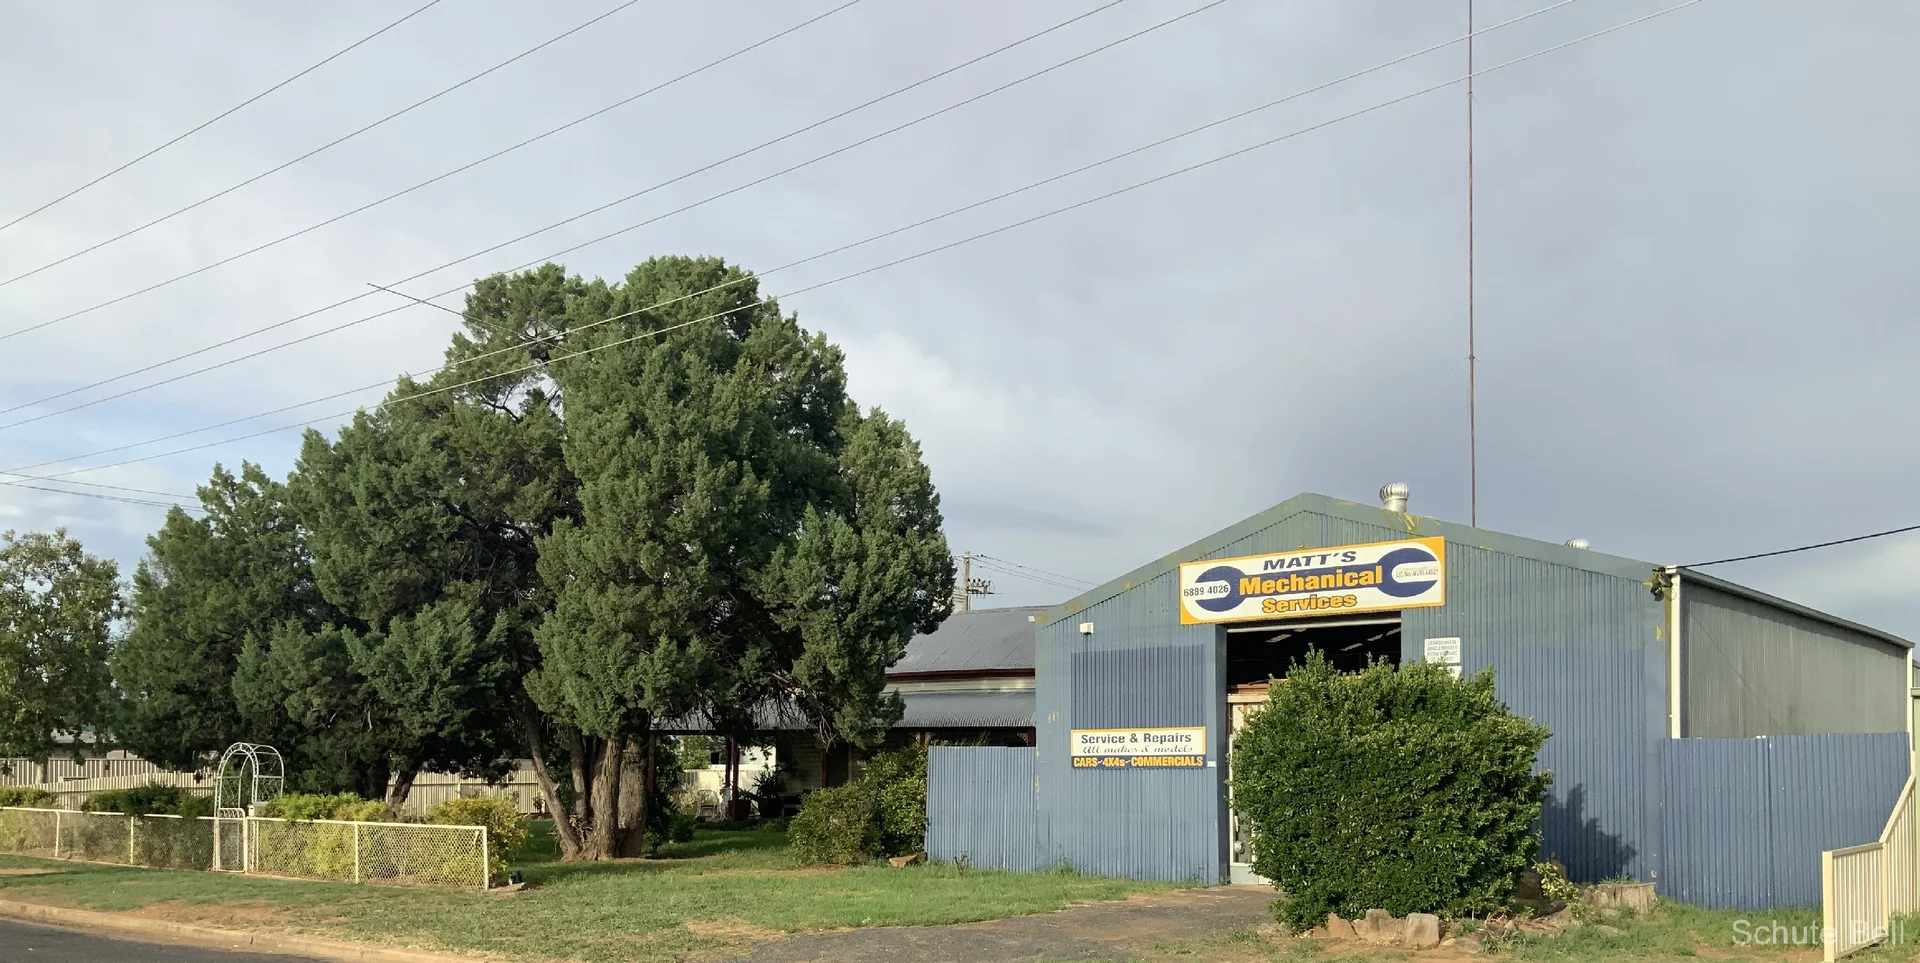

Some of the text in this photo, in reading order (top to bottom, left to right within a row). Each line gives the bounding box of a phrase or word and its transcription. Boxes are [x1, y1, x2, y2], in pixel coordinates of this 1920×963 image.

[1263, 550, 1357, 571] MATT'S
[1239, 565, 1383, 596] Mechanical
[1183, 584, 1229, 597] 6889 4026
[1262, 594, 1358, 613] Services
[1081, 733, 1192, 744] Service & Repairs
[1104, 745, 1138, 753] makes
[1141, 744, 1150, 753] &
[1154, 744, 1193, 753] models
[1130, 756, 1203, 767] COMMERCIALS
